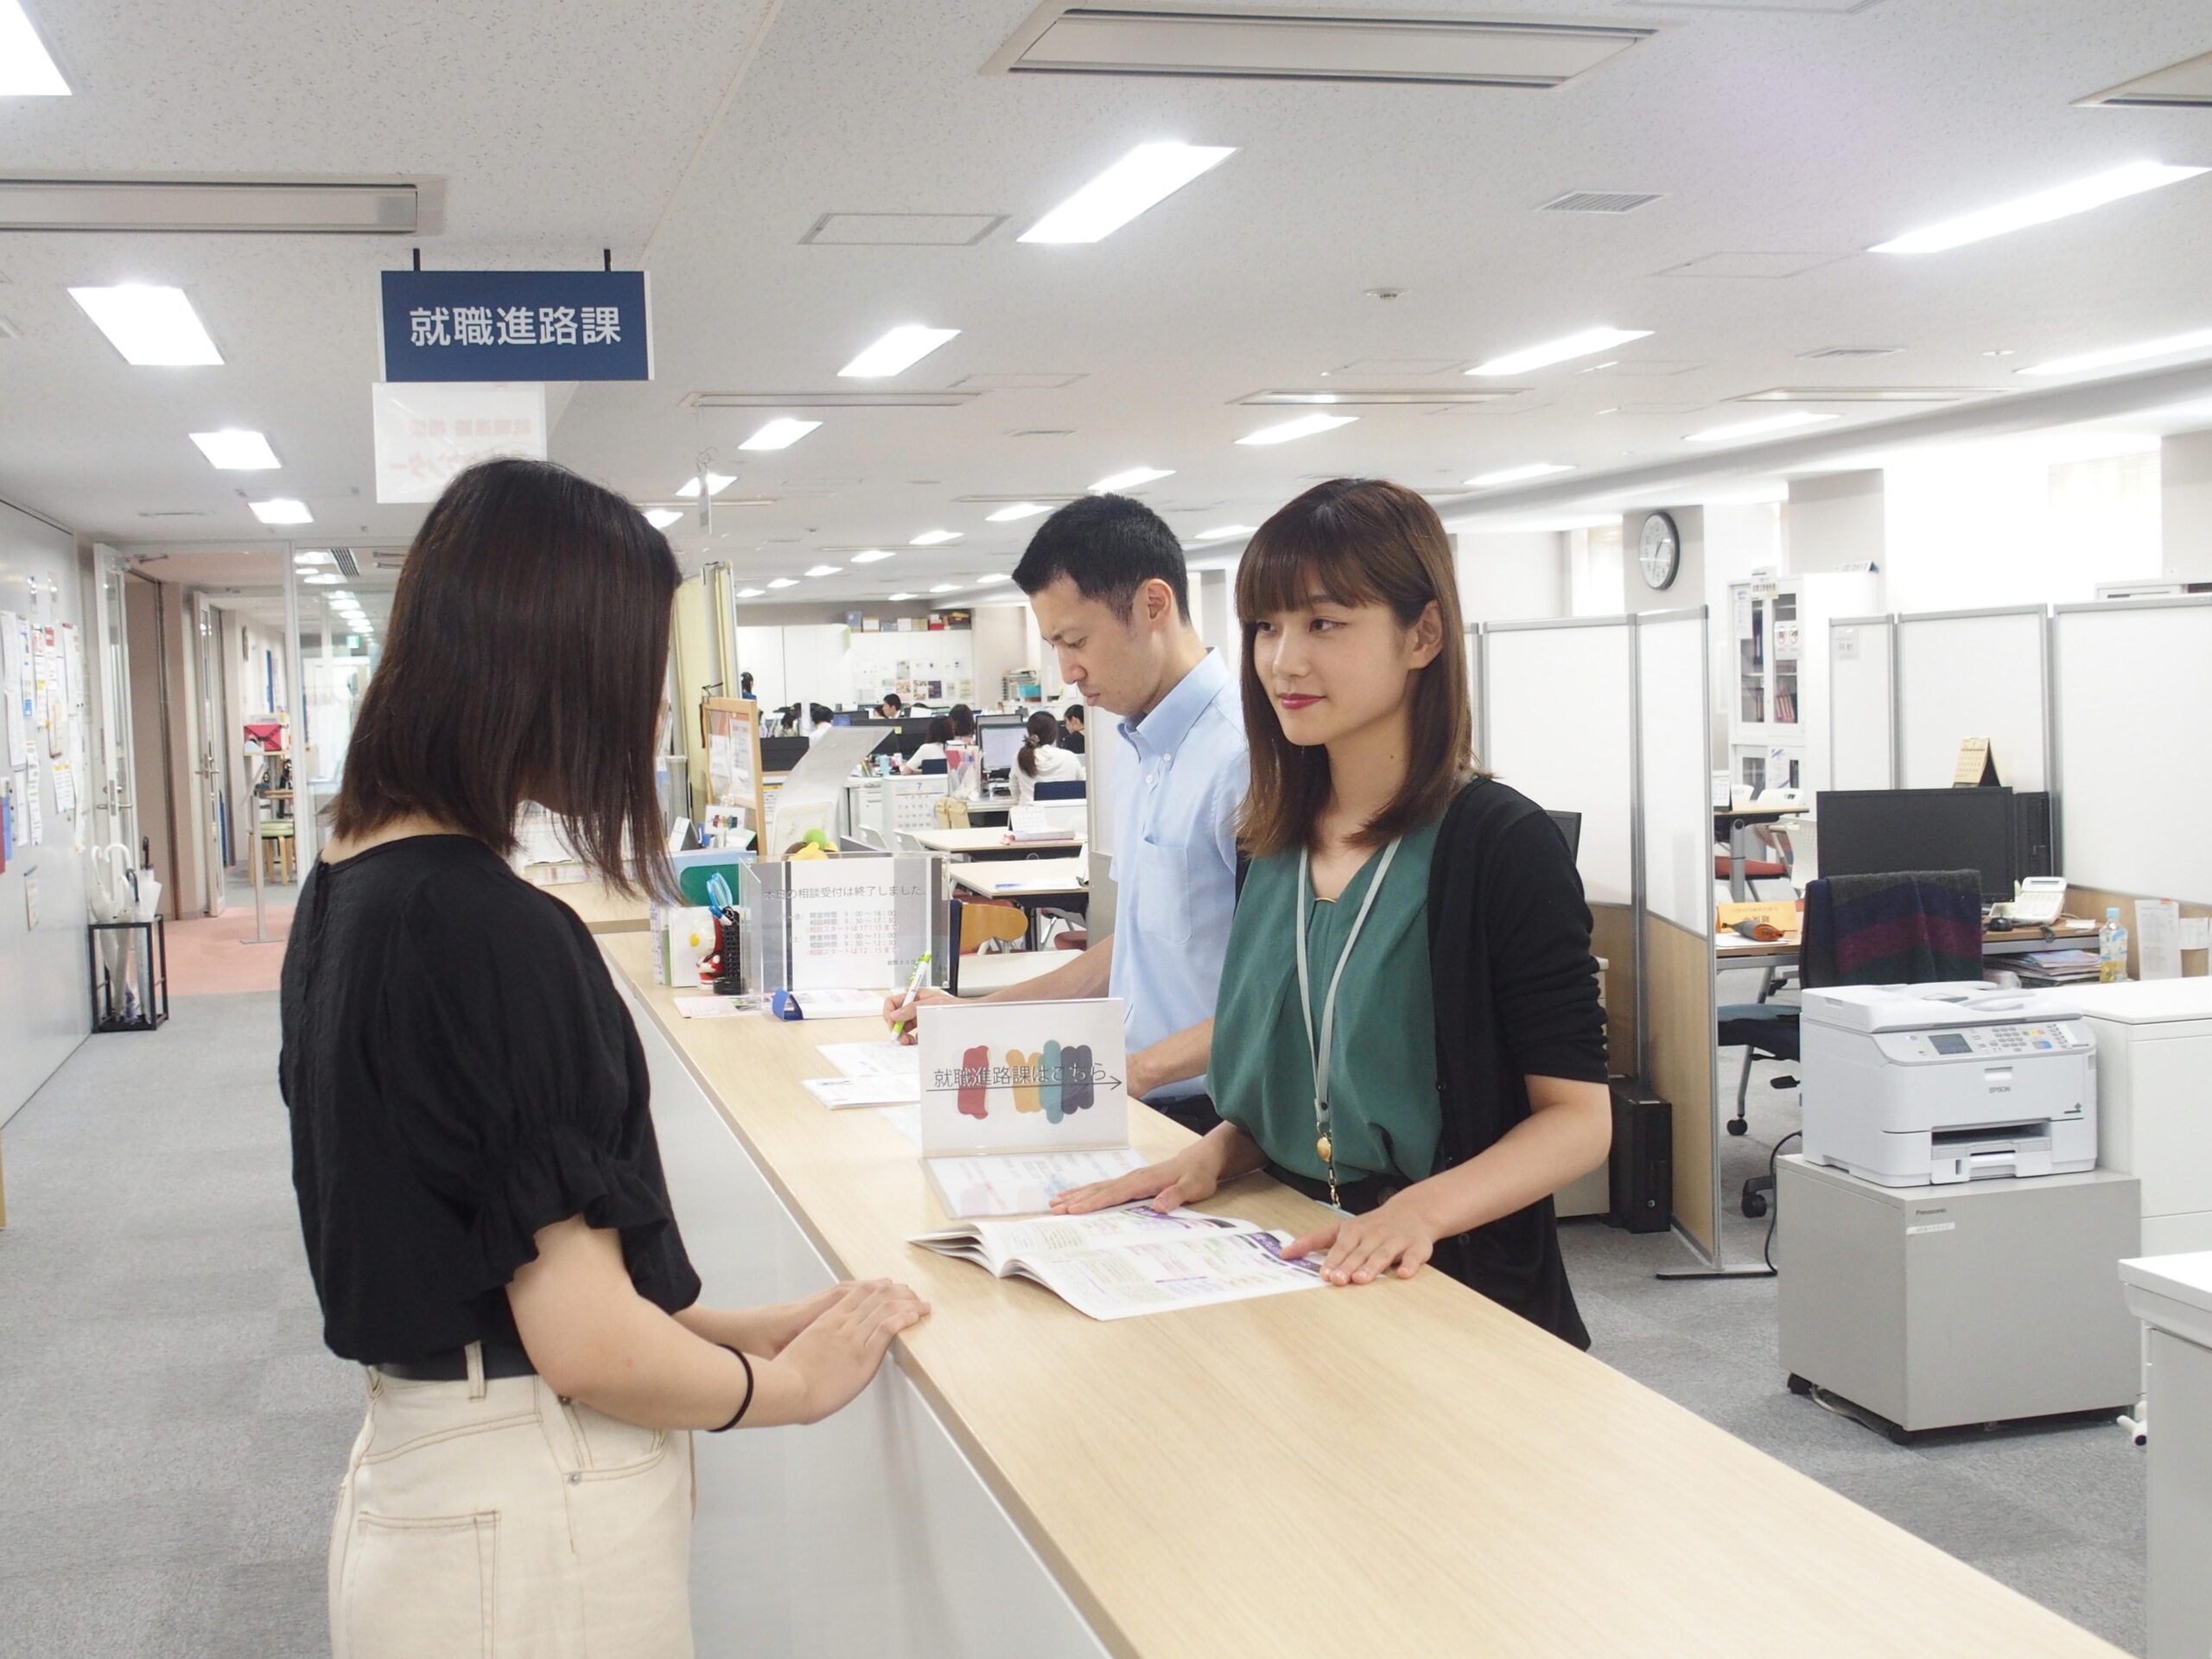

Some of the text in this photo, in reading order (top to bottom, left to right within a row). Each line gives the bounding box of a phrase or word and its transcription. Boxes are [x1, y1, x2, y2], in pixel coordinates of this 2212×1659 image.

[410, 306, 621, 346] 就職進路課
[933, 1062, 1107, 1088] 就職進路課はこちら
